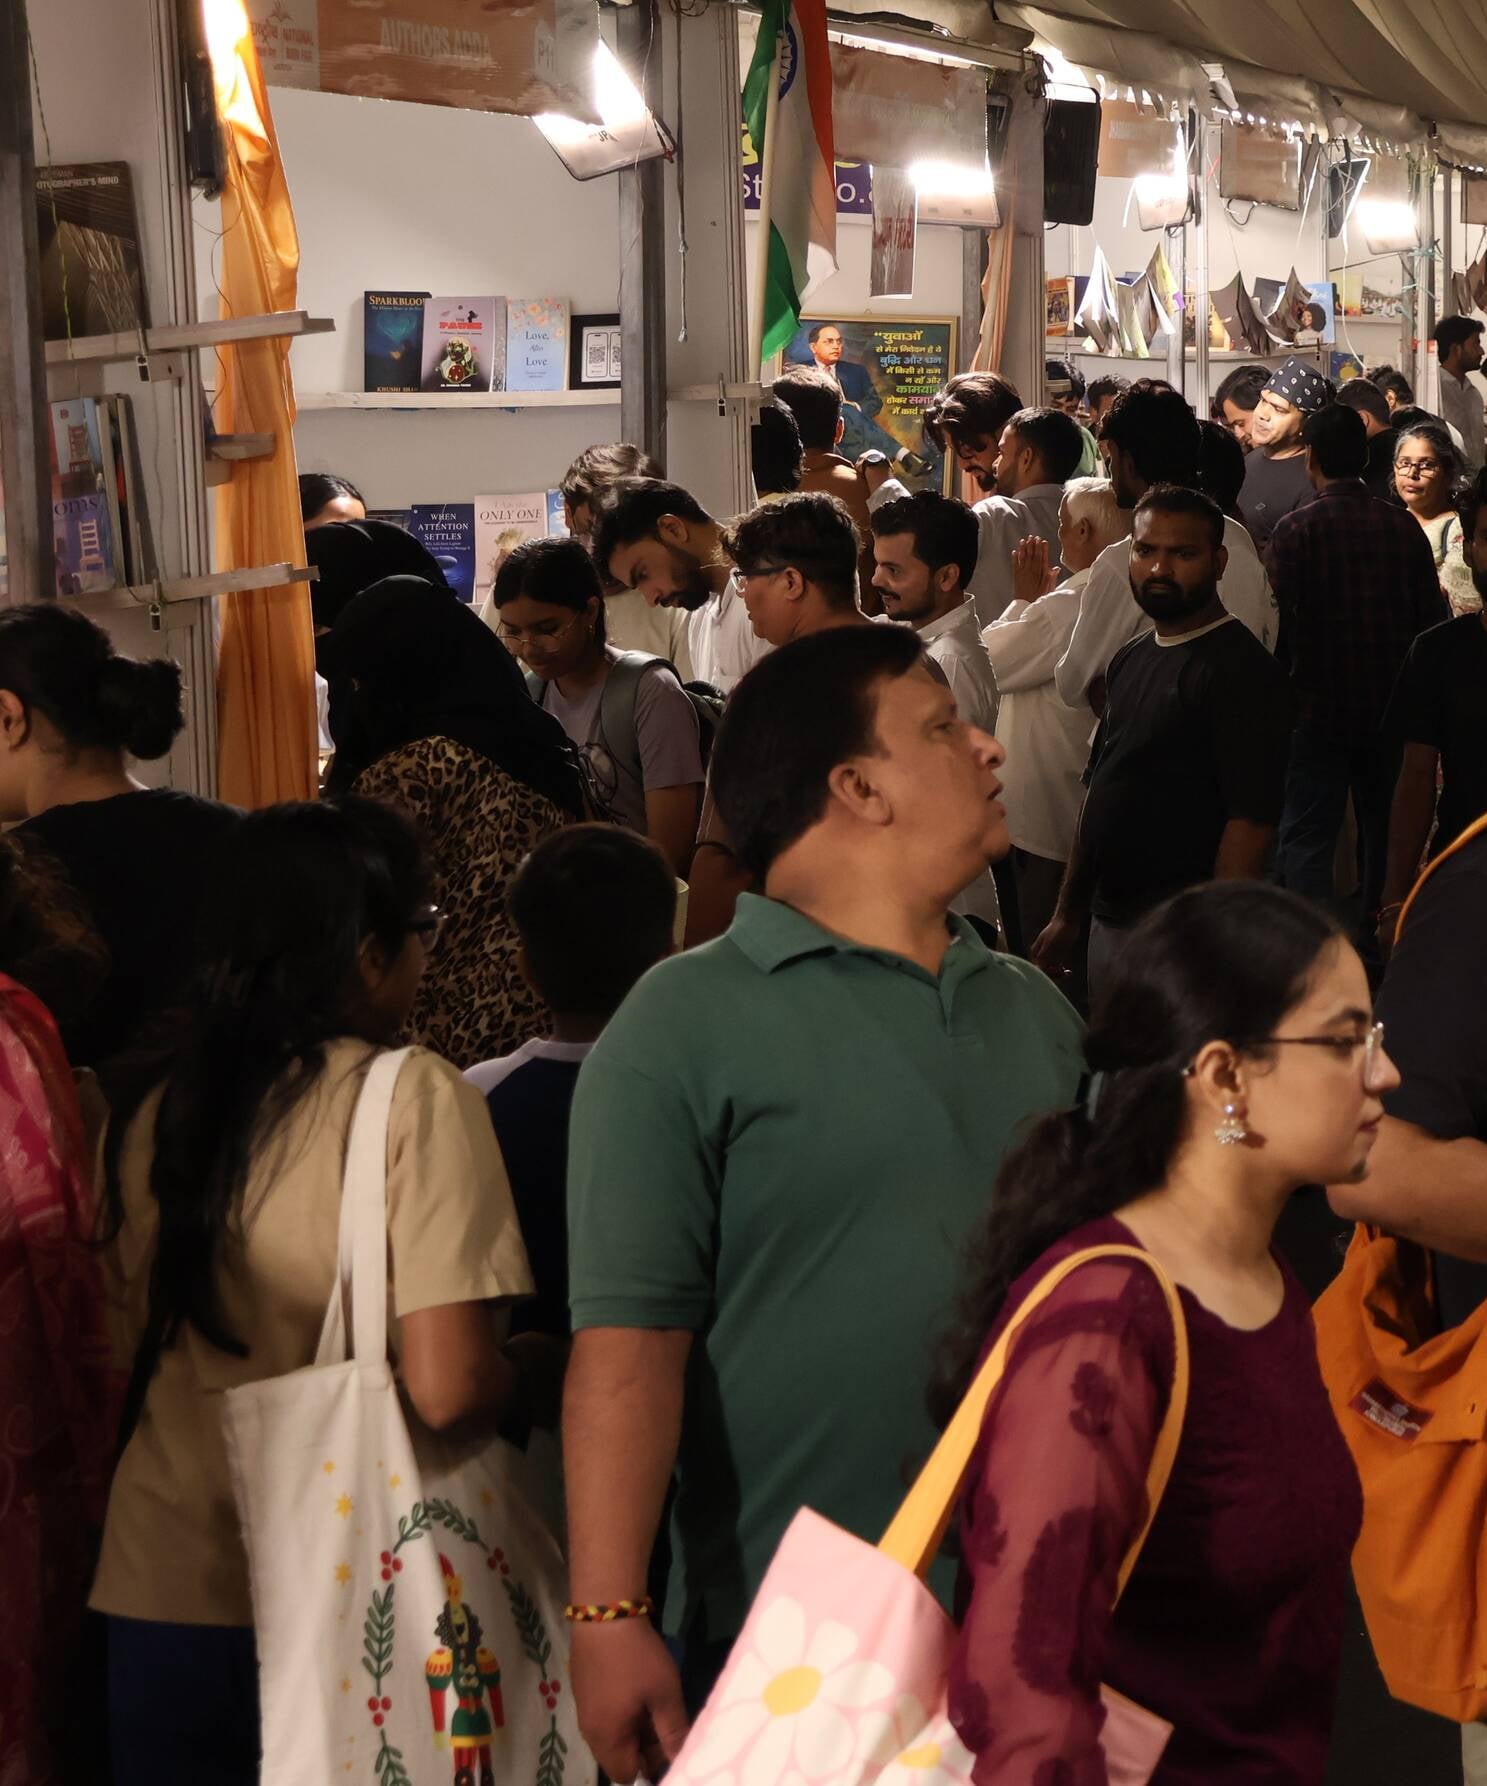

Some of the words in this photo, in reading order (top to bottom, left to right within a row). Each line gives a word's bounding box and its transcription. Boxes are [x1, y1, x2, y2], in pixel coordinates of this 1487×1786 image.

[36, 177, 97, 190] OTOGRAPHER'S
[97, 175, 119, 185] MIND
[525, 330, 550, 341] Love,
[525, 357, 548, 367] Love
[904, 354, 922, 365] और
[908, 396, 934, 405] समा
[430, 513, 457, 521] WHEN
[479, 509, 514, 520] ONLY
[516, 508, 542, 519] ONE
[424, 533, 462, 541] SETTLES
